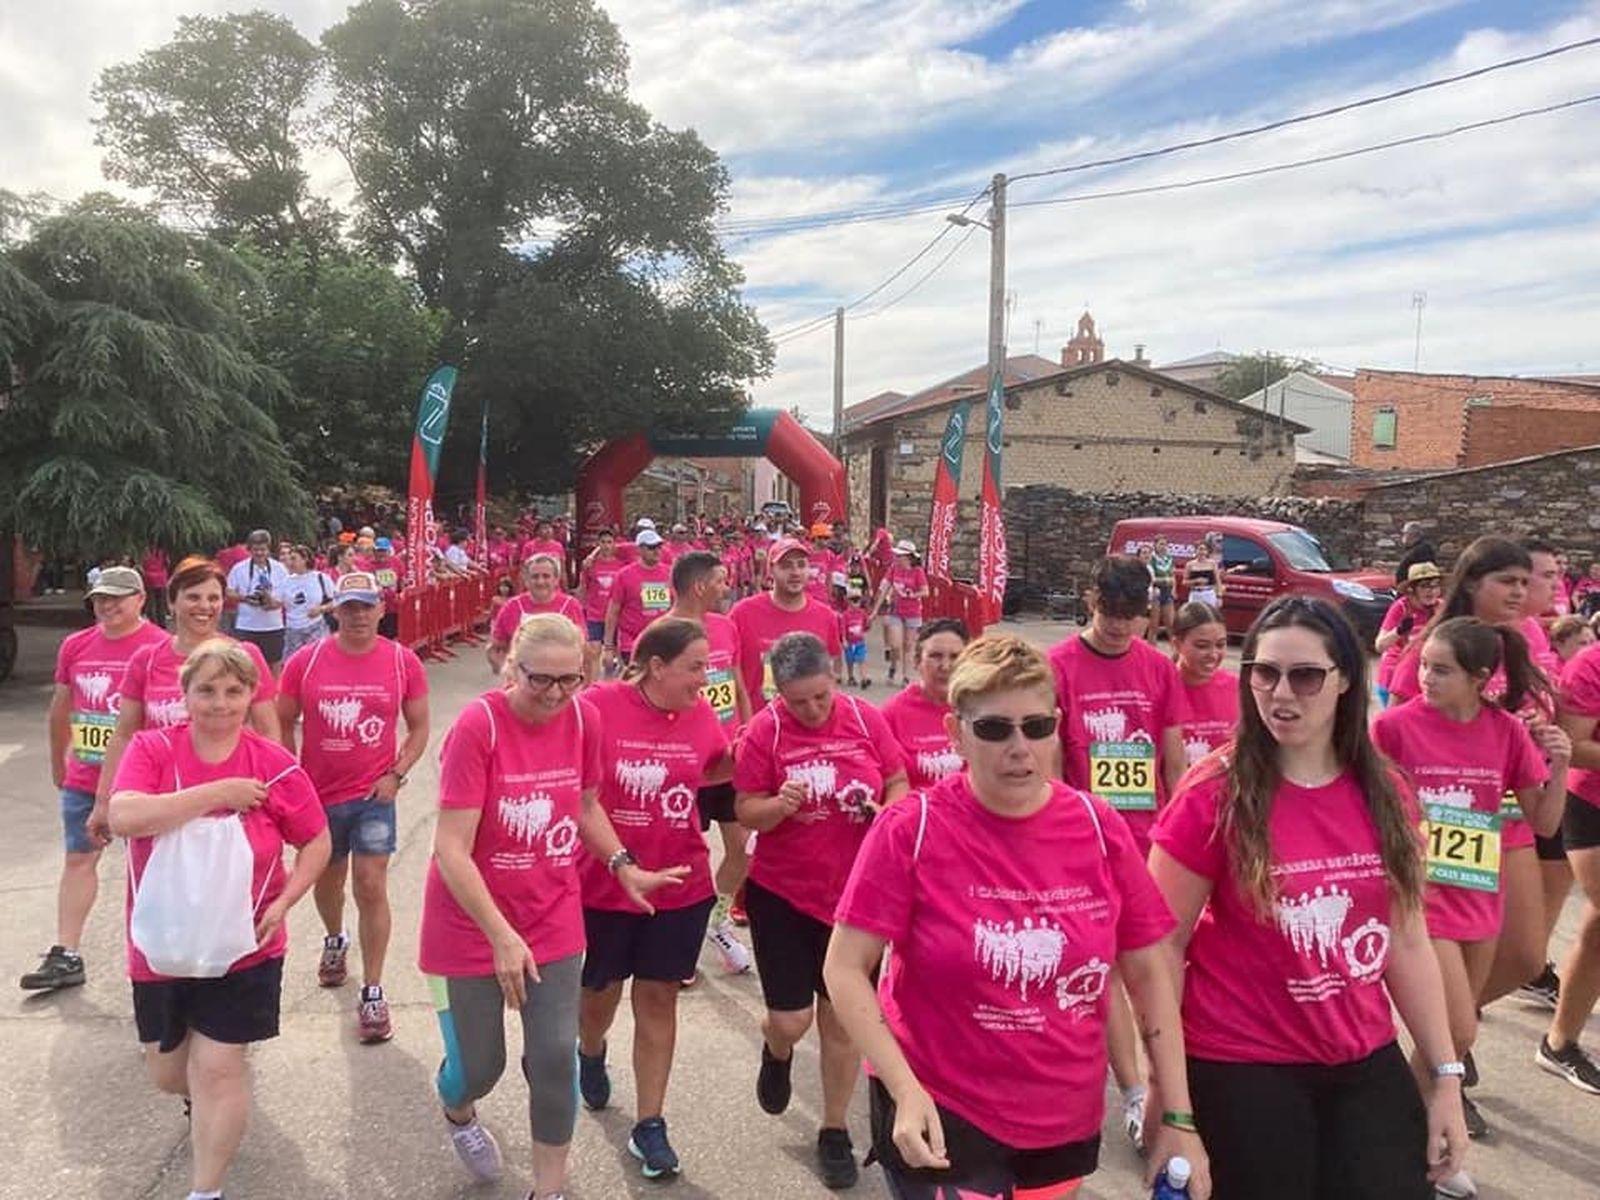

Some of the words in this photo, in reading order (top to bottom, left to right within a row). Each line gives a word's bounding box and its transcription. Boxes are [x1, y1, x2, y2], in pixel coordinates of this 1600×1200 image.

[645, 589, 667, 601] 176
[700, 683, 733, 708] 23
[1096, 761, 1148, 788] 285
[1429, 826, 1485, 864] 121
